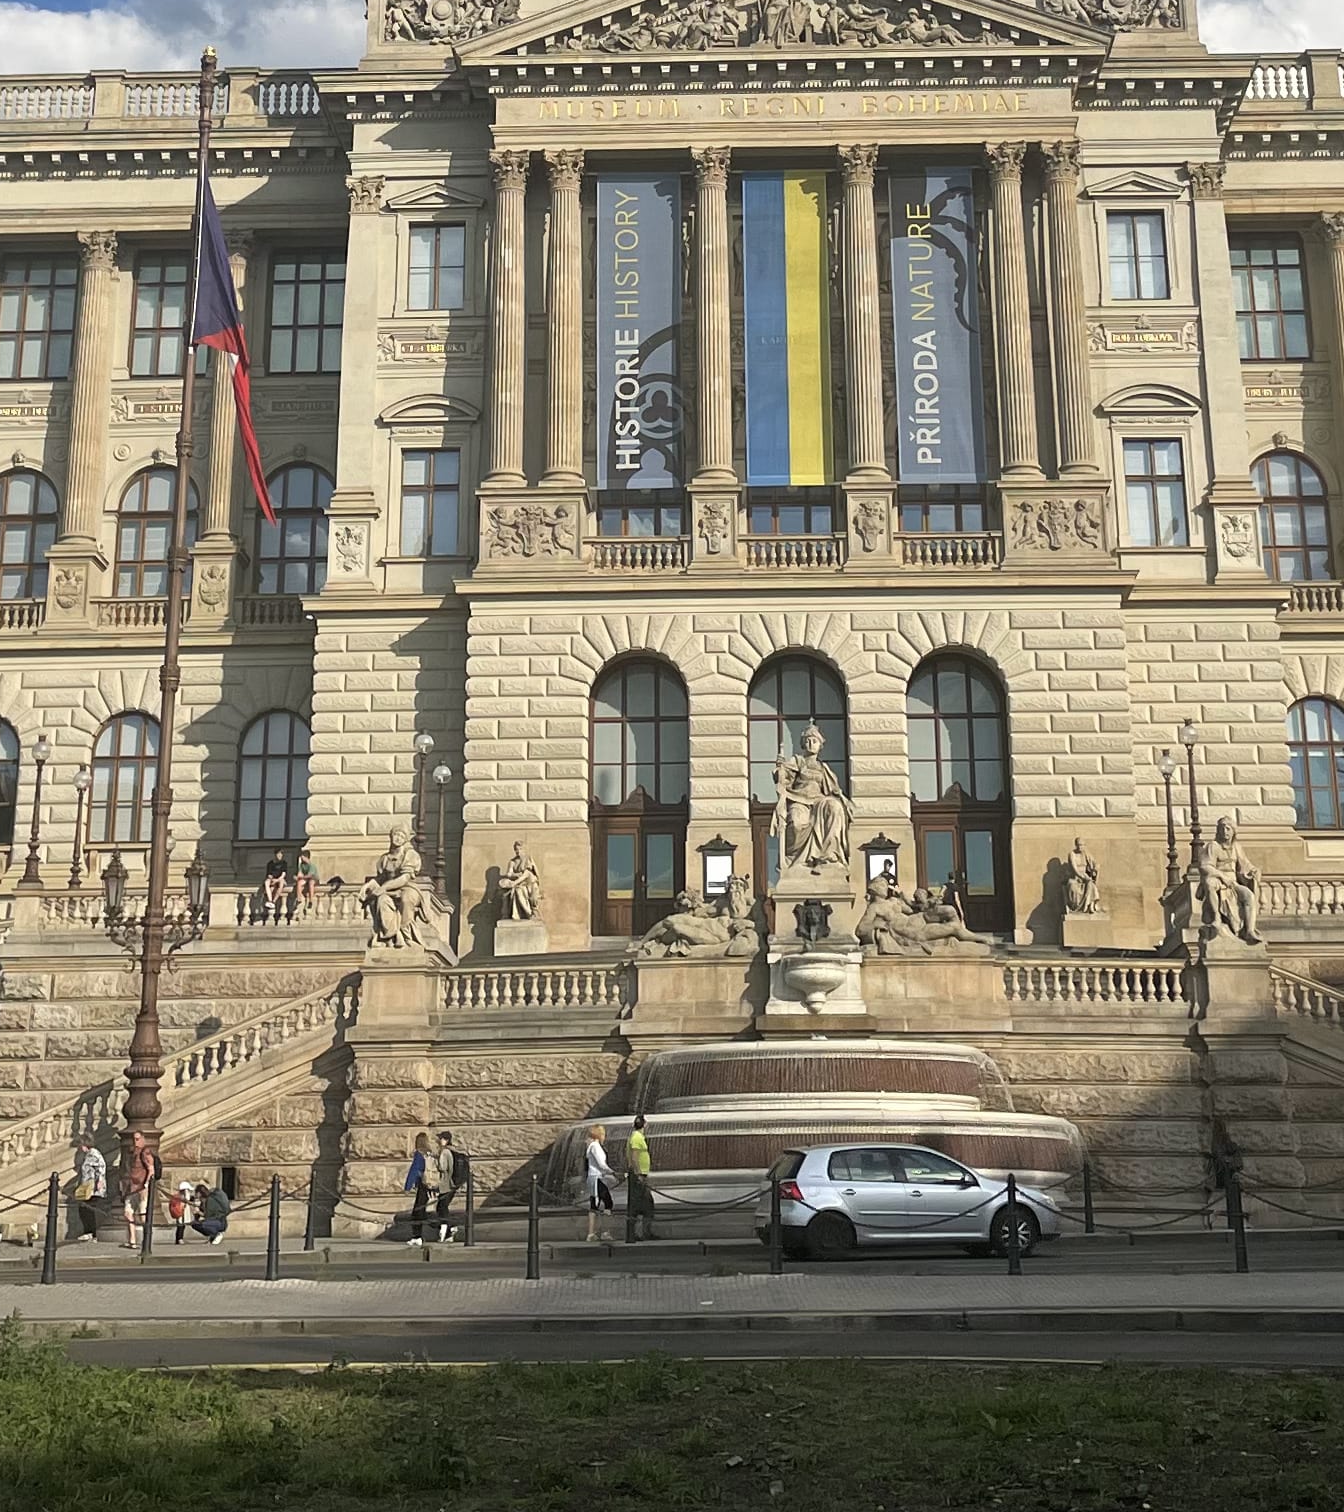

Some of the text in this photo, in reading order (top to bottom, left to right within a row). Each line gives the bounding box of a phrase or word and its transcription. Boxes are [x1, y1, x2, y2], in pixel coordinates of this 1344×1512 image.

[539, 92, 1030, 119] MUSEUM REGNI BOHEMIAE
[614, 189, 640, 470] HISTORIE HISTORY
[906, 203, 942, 464] PŘÍRODA NATURE
